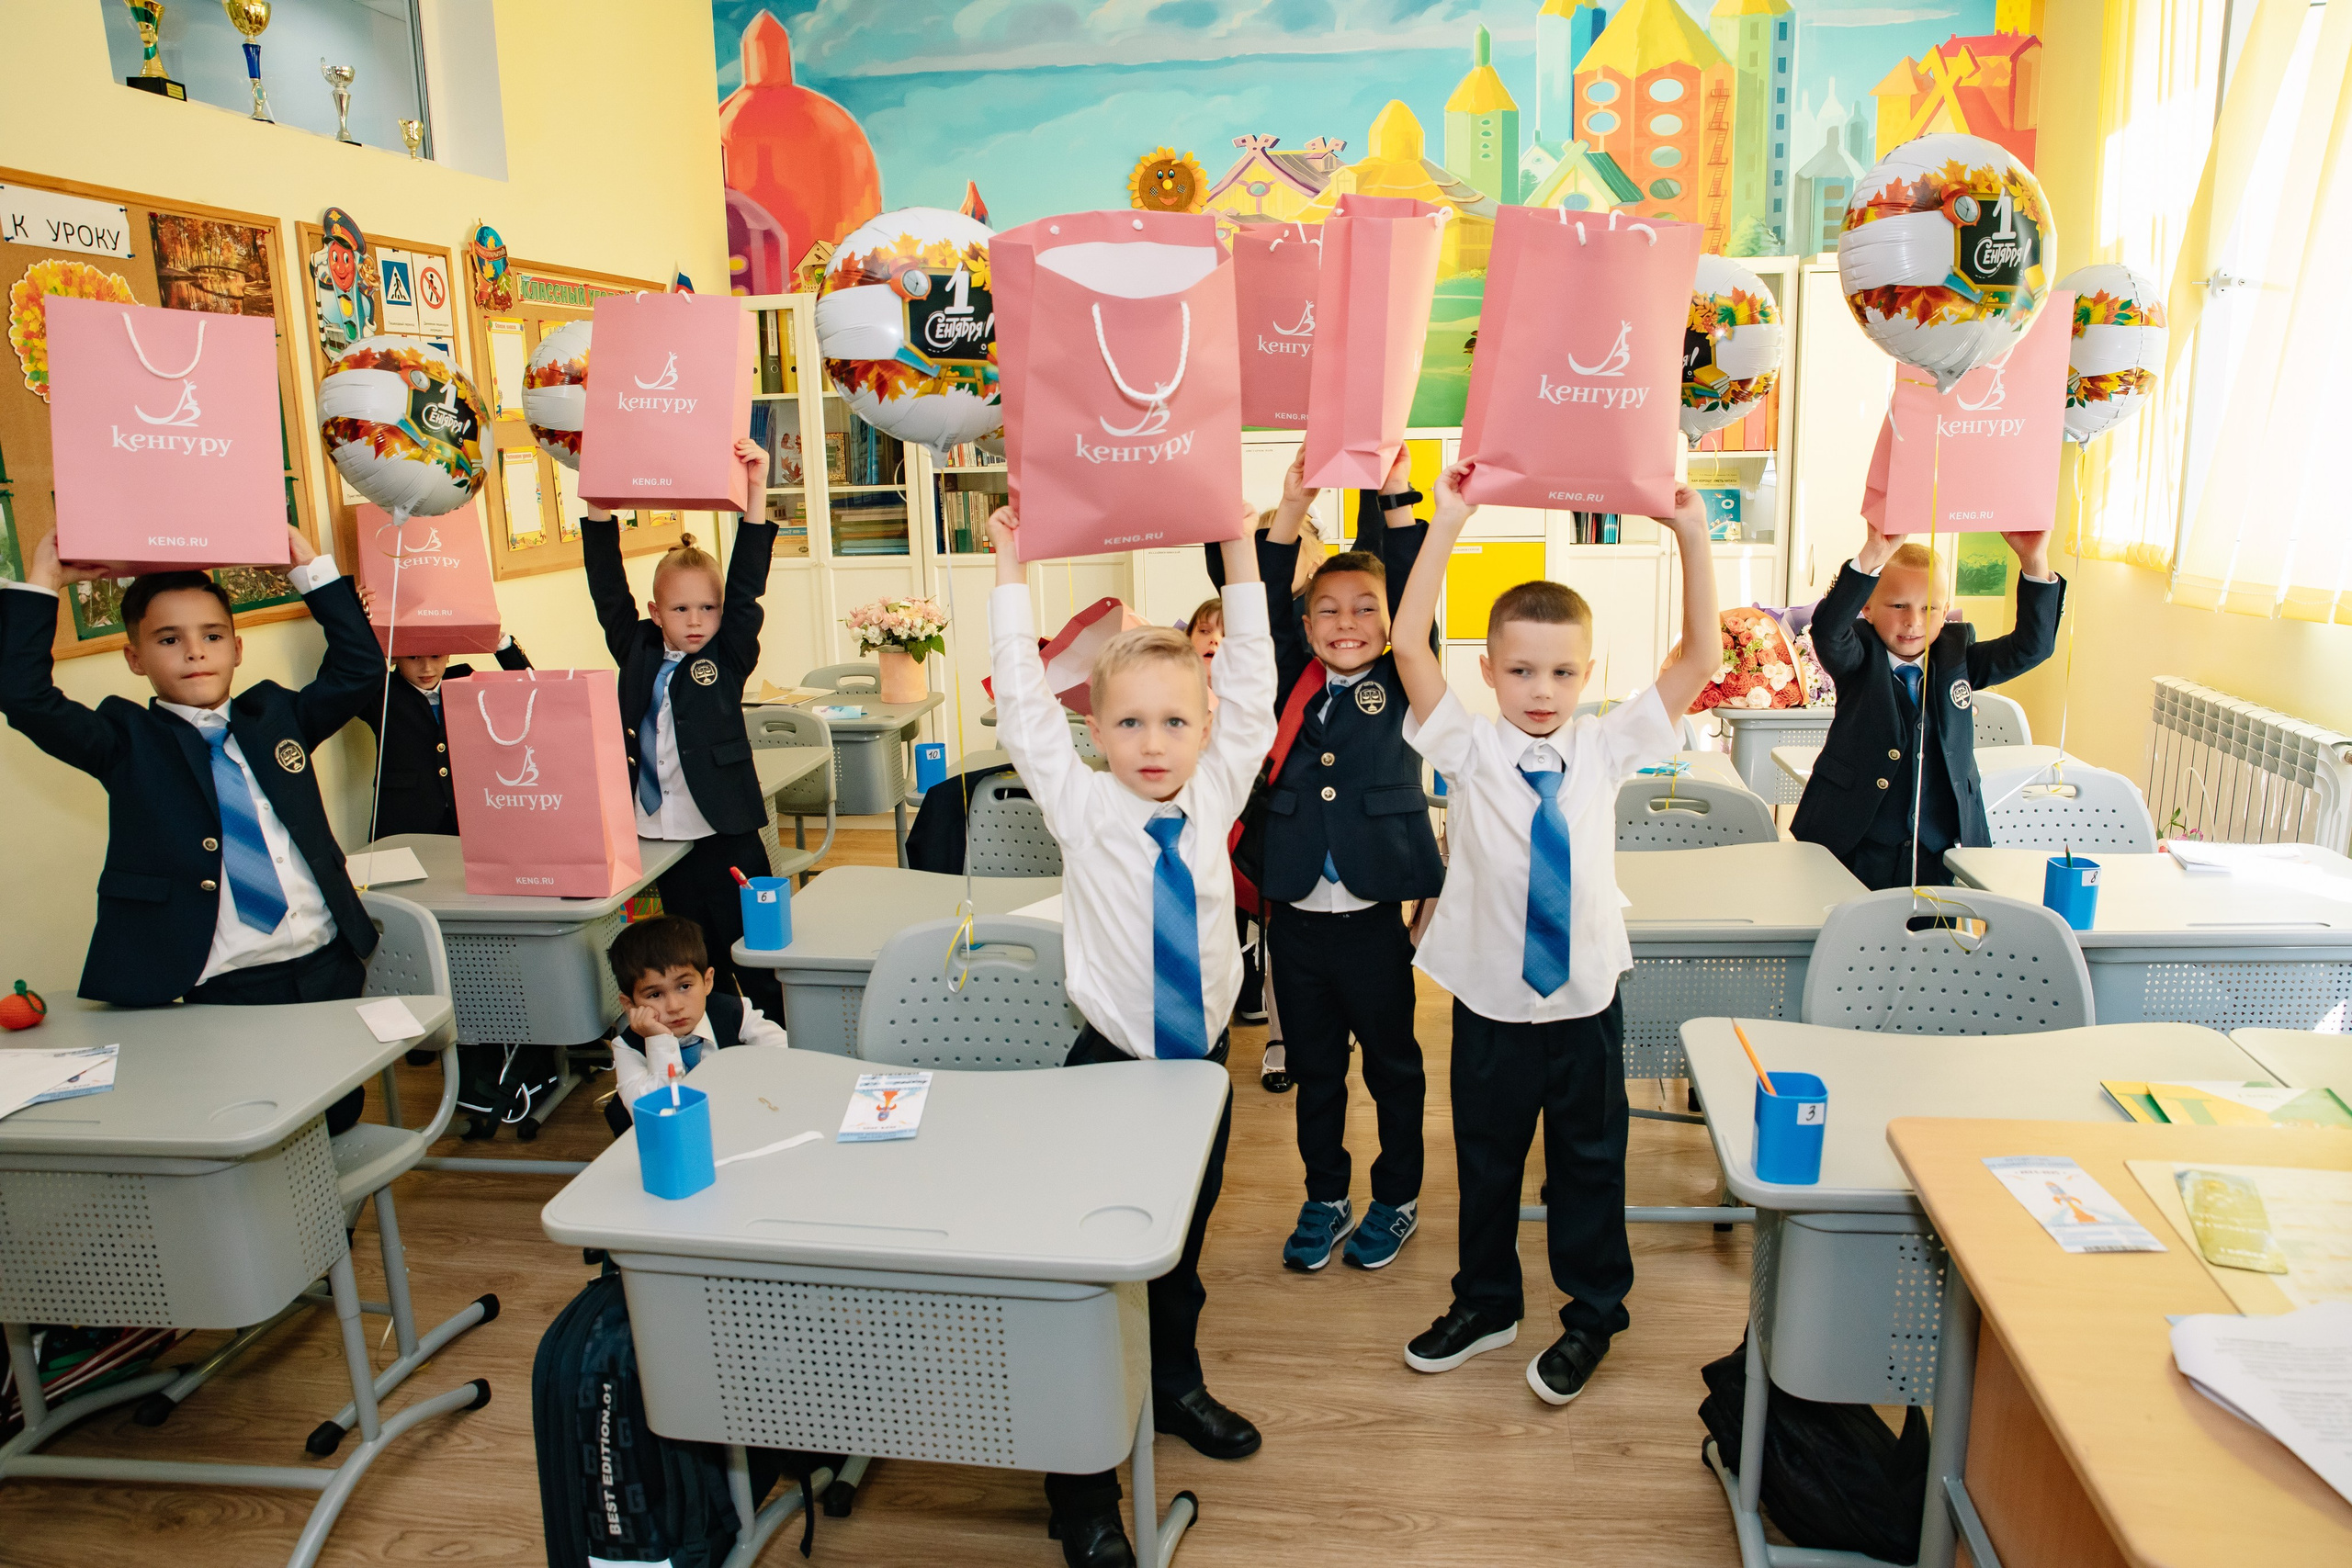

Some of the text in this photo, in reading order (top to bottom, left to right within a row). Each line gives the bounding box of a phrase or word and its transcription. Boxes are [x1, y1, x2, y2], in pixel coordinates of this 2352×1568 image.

[1992, 186, 2017, 241] 1
[12, 213, 120, 251] К УРОКУ
[521, 280, 587, 306] КЛАССНЫЙ
[944, 262, 975, 315] 1
[1257, 334, 1314, 357] кенгу
[439, 378, 459, 414] 1
[616, 392, 698, 413] кенгуру
[1536, 374, 1651, 410] кенгуру
[1935, 413, 2027, 438] кенгуру
[110, 424, 233, 457] кенгуру
[1075, 429, 1195, 465] кенгуру
[632, 478, 673, 486] KENG.RU
[1548, 491, 1604, 502] KENG.RU
[1949, 511, 1995, 521] KENG.RU
[148, 536, 209, 547] KENG.RU
[1103, 531, 1164, 546] KENG.RU
[393, 556, 460, 570] кенгуру
[928, 750, 939, 759] 10
[484, 788, 563, 810] кенгуру
[514, 876, 555, 886] KENG.RU
[2090, 870, 2099, 884] 8
[760, 891, 768, 903] 6
[1805, 1104, 1816, 1122] 3
[1389, 1216, 1409, 1238] N
[599, 1382, 623, 1536] BEST EDITION.01
